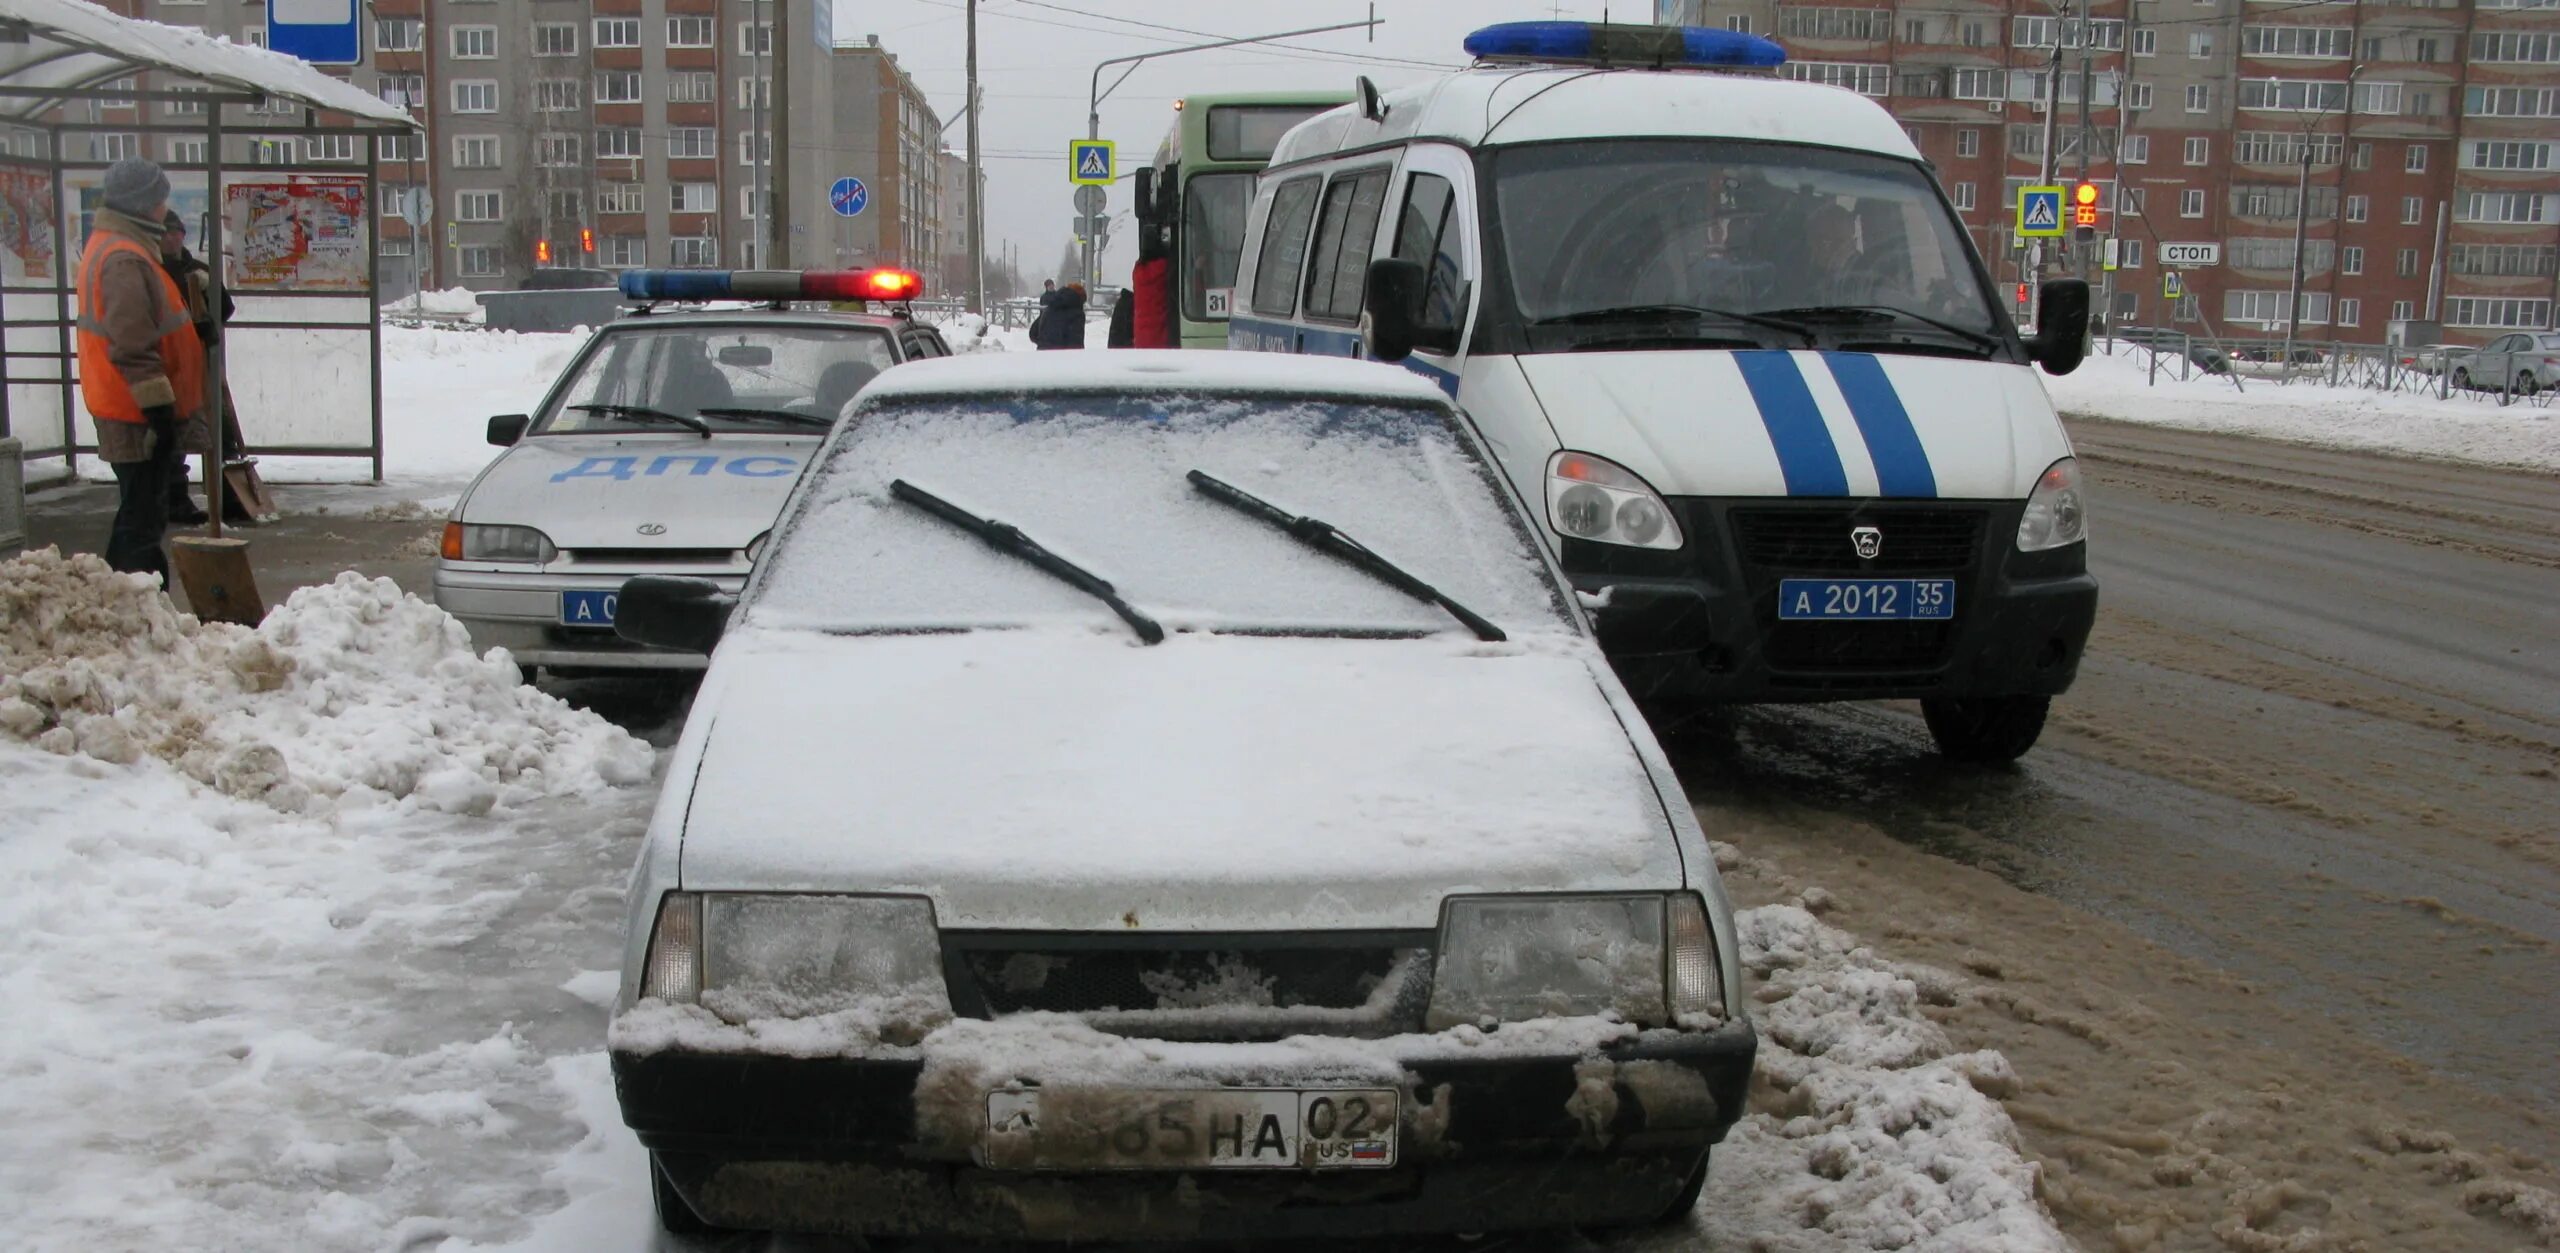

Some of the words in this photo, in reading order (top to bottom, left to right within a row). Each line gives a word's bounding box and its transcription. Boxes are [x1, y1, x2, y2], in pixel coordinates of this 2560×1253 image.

[2168, 246, 2210, 260] СТОП
[1209, 294, 1226, 312] 31
[548, 455, 799, 483] ДПС
[1824, 584, 1898, 614] 2012
[1916, 583, 1944, 605] 35
[1918, 606, 1939, 615] RUS
[1307, 1096, 1372, 1140] 02
[1304, 1142, 1350, 1158] US
